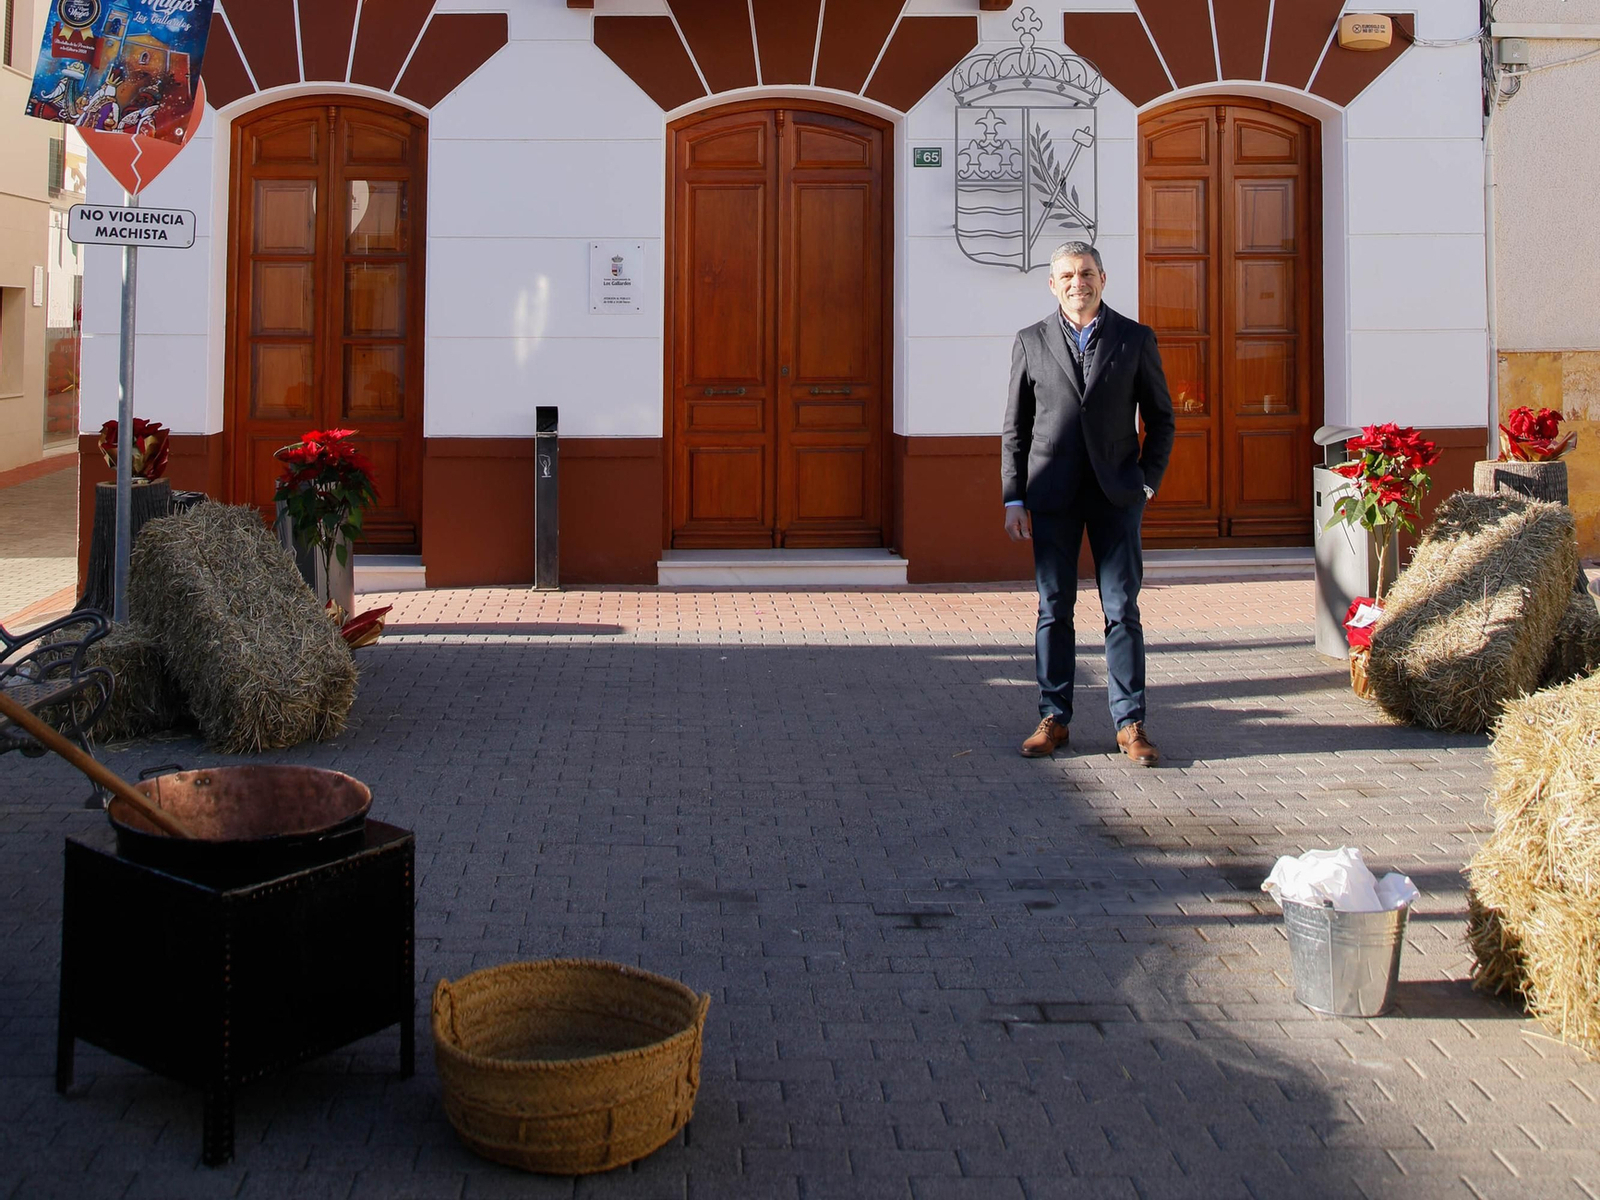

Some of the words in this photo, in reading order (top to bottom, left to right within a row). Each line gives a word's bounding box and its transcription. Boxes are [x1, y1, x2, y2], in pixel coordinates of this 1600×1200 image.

[133, 11, 148, 25] Los
[150, 12, 192, 32] Gallardos
[923, 151, 939, 163] 65
[80, 209, 104, 221] NO
[108, 210, 184, 226] VIOLENCIA
[95, 226, 168, 241] MACHISTA
